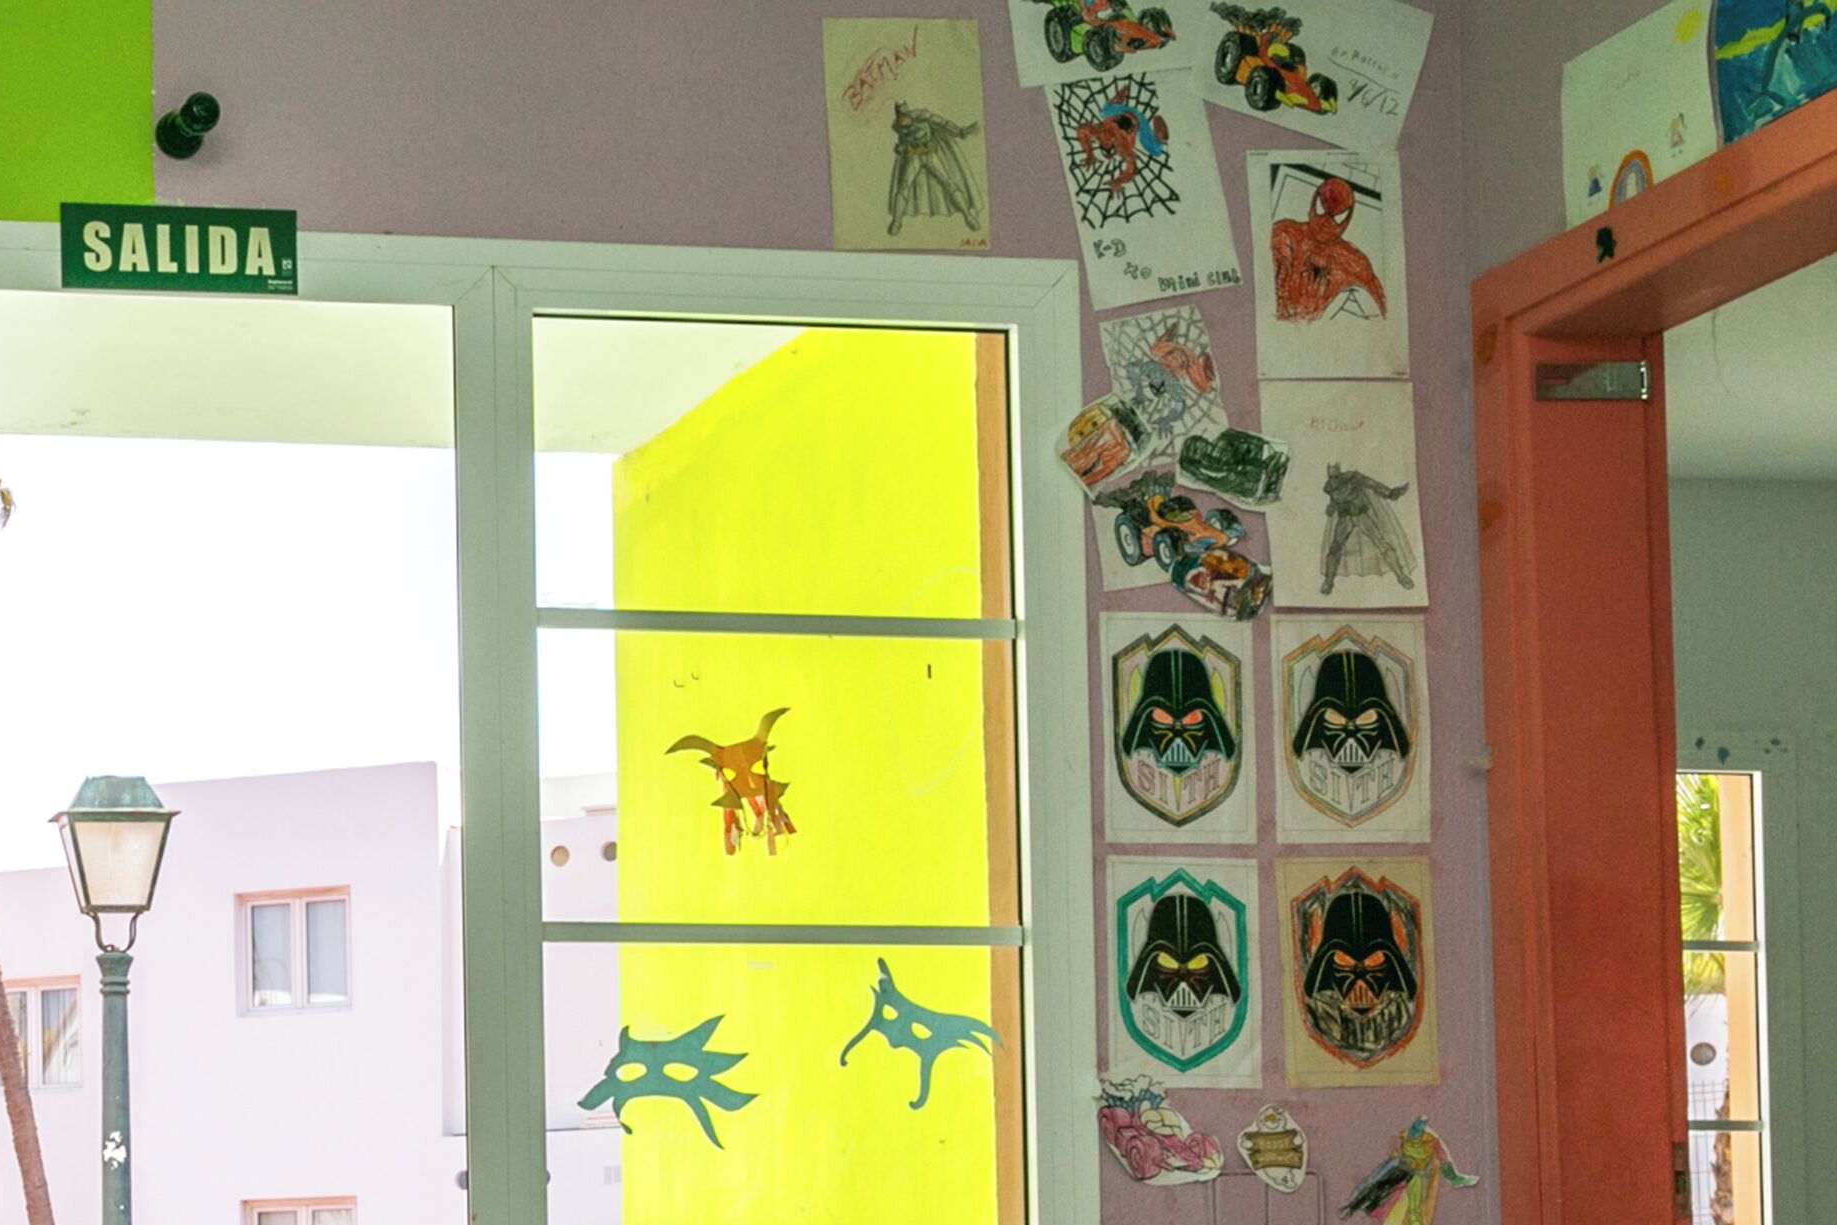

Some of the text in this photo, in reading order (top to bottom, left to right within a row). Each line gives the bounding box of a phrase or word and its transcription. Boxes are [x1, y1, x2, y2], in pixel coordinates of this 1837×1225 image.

[842, 24, 918, 111] BATMAN
[82, 220, 276, 276] SALIDA
[1137, 757, 1221, 806] SITH
[1309, 757, 1395, 806] SITH
[1141, 1002, 1227, 1050] SITH
